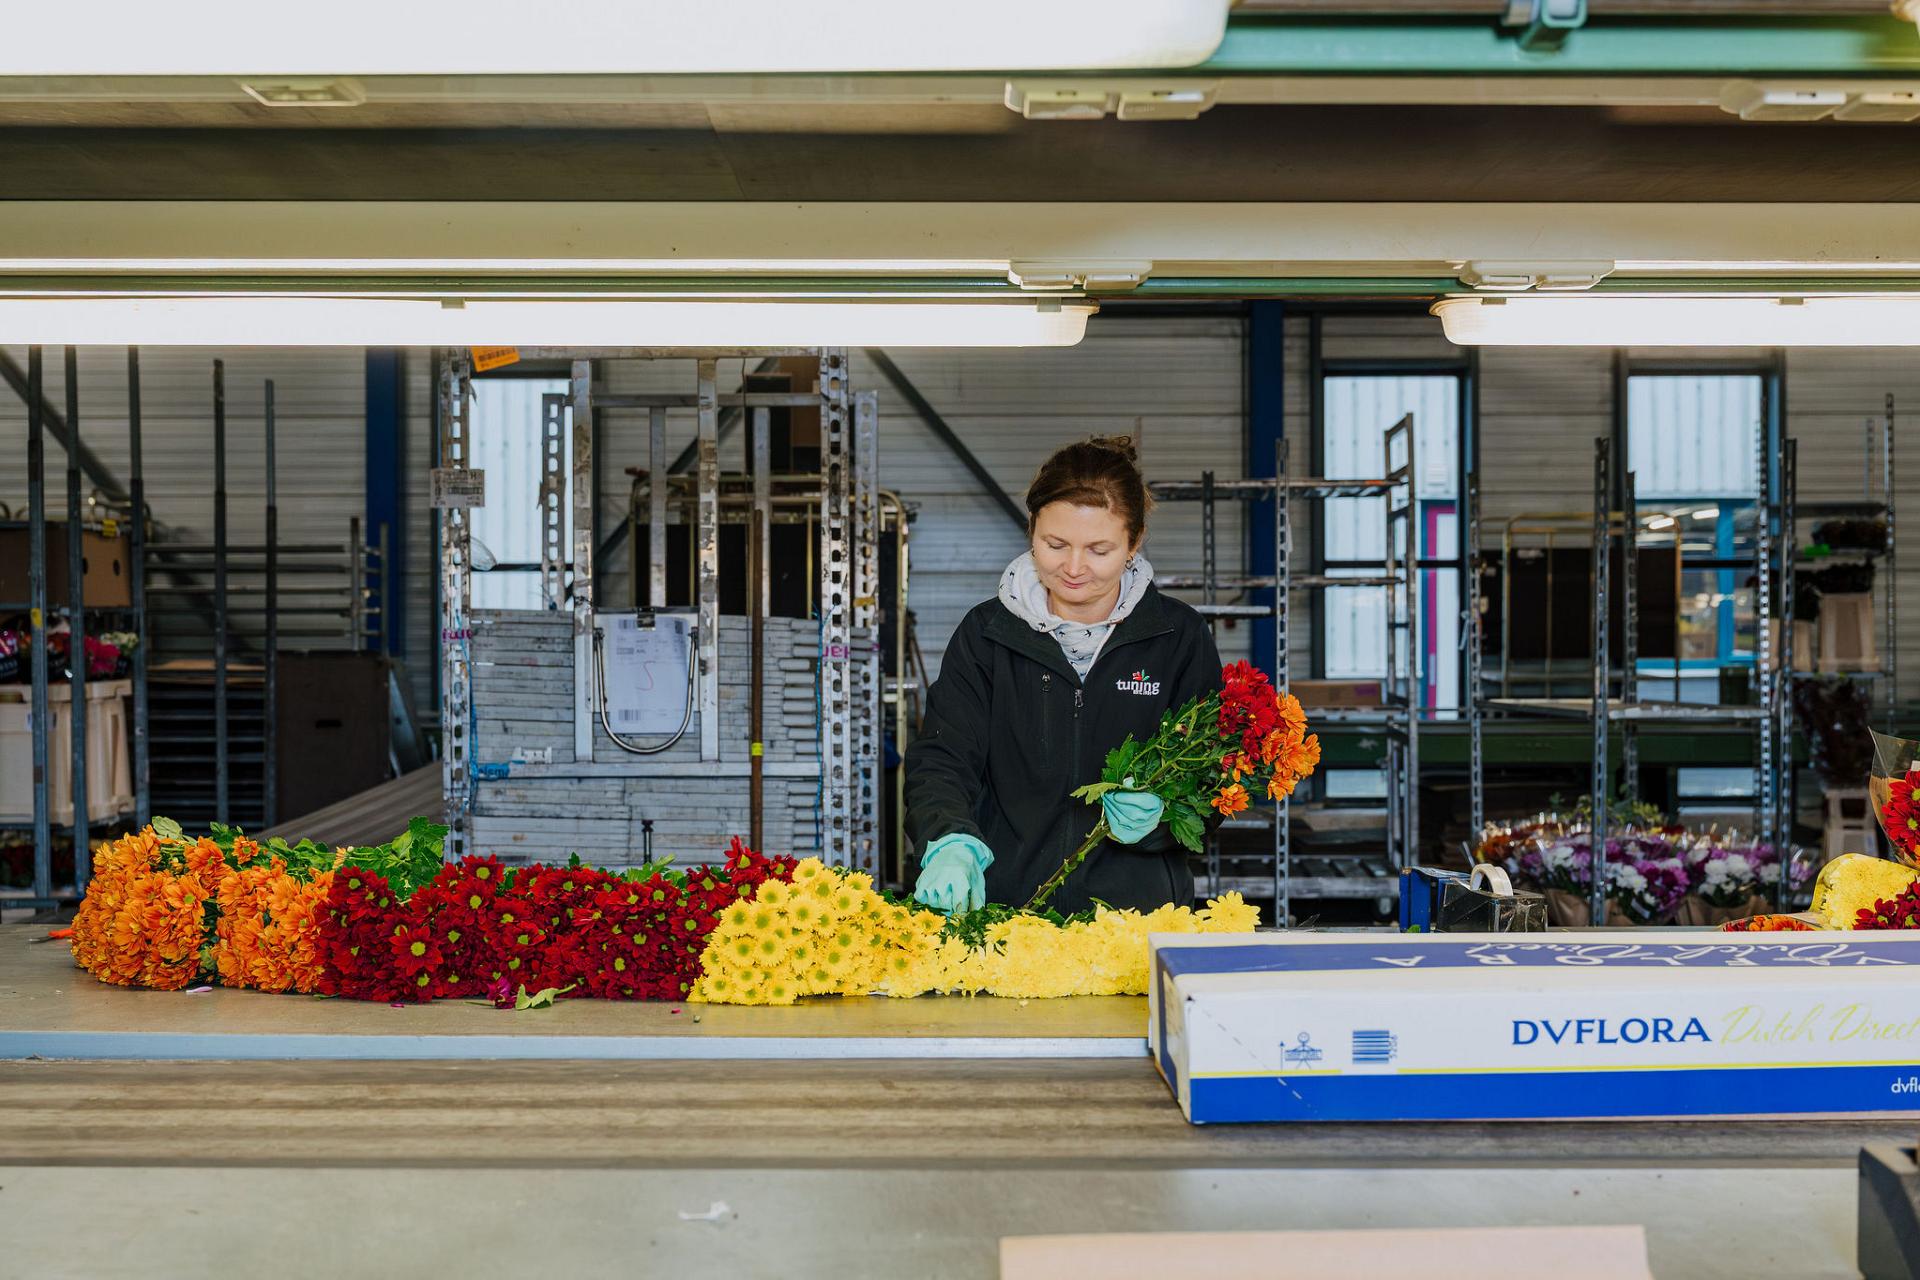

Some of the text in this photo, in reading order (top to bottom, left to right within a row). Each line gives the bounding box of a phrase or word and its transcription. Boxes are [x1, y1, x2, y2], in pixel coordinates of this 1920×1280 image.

[1116, 679, 1160, 695] tuning
[1512, 1017, 1711, 1045] DVFLORA
[1720, 1003, 1824, 1046] Dutch
[1891, 1076, 1920, 1094] dvfl
